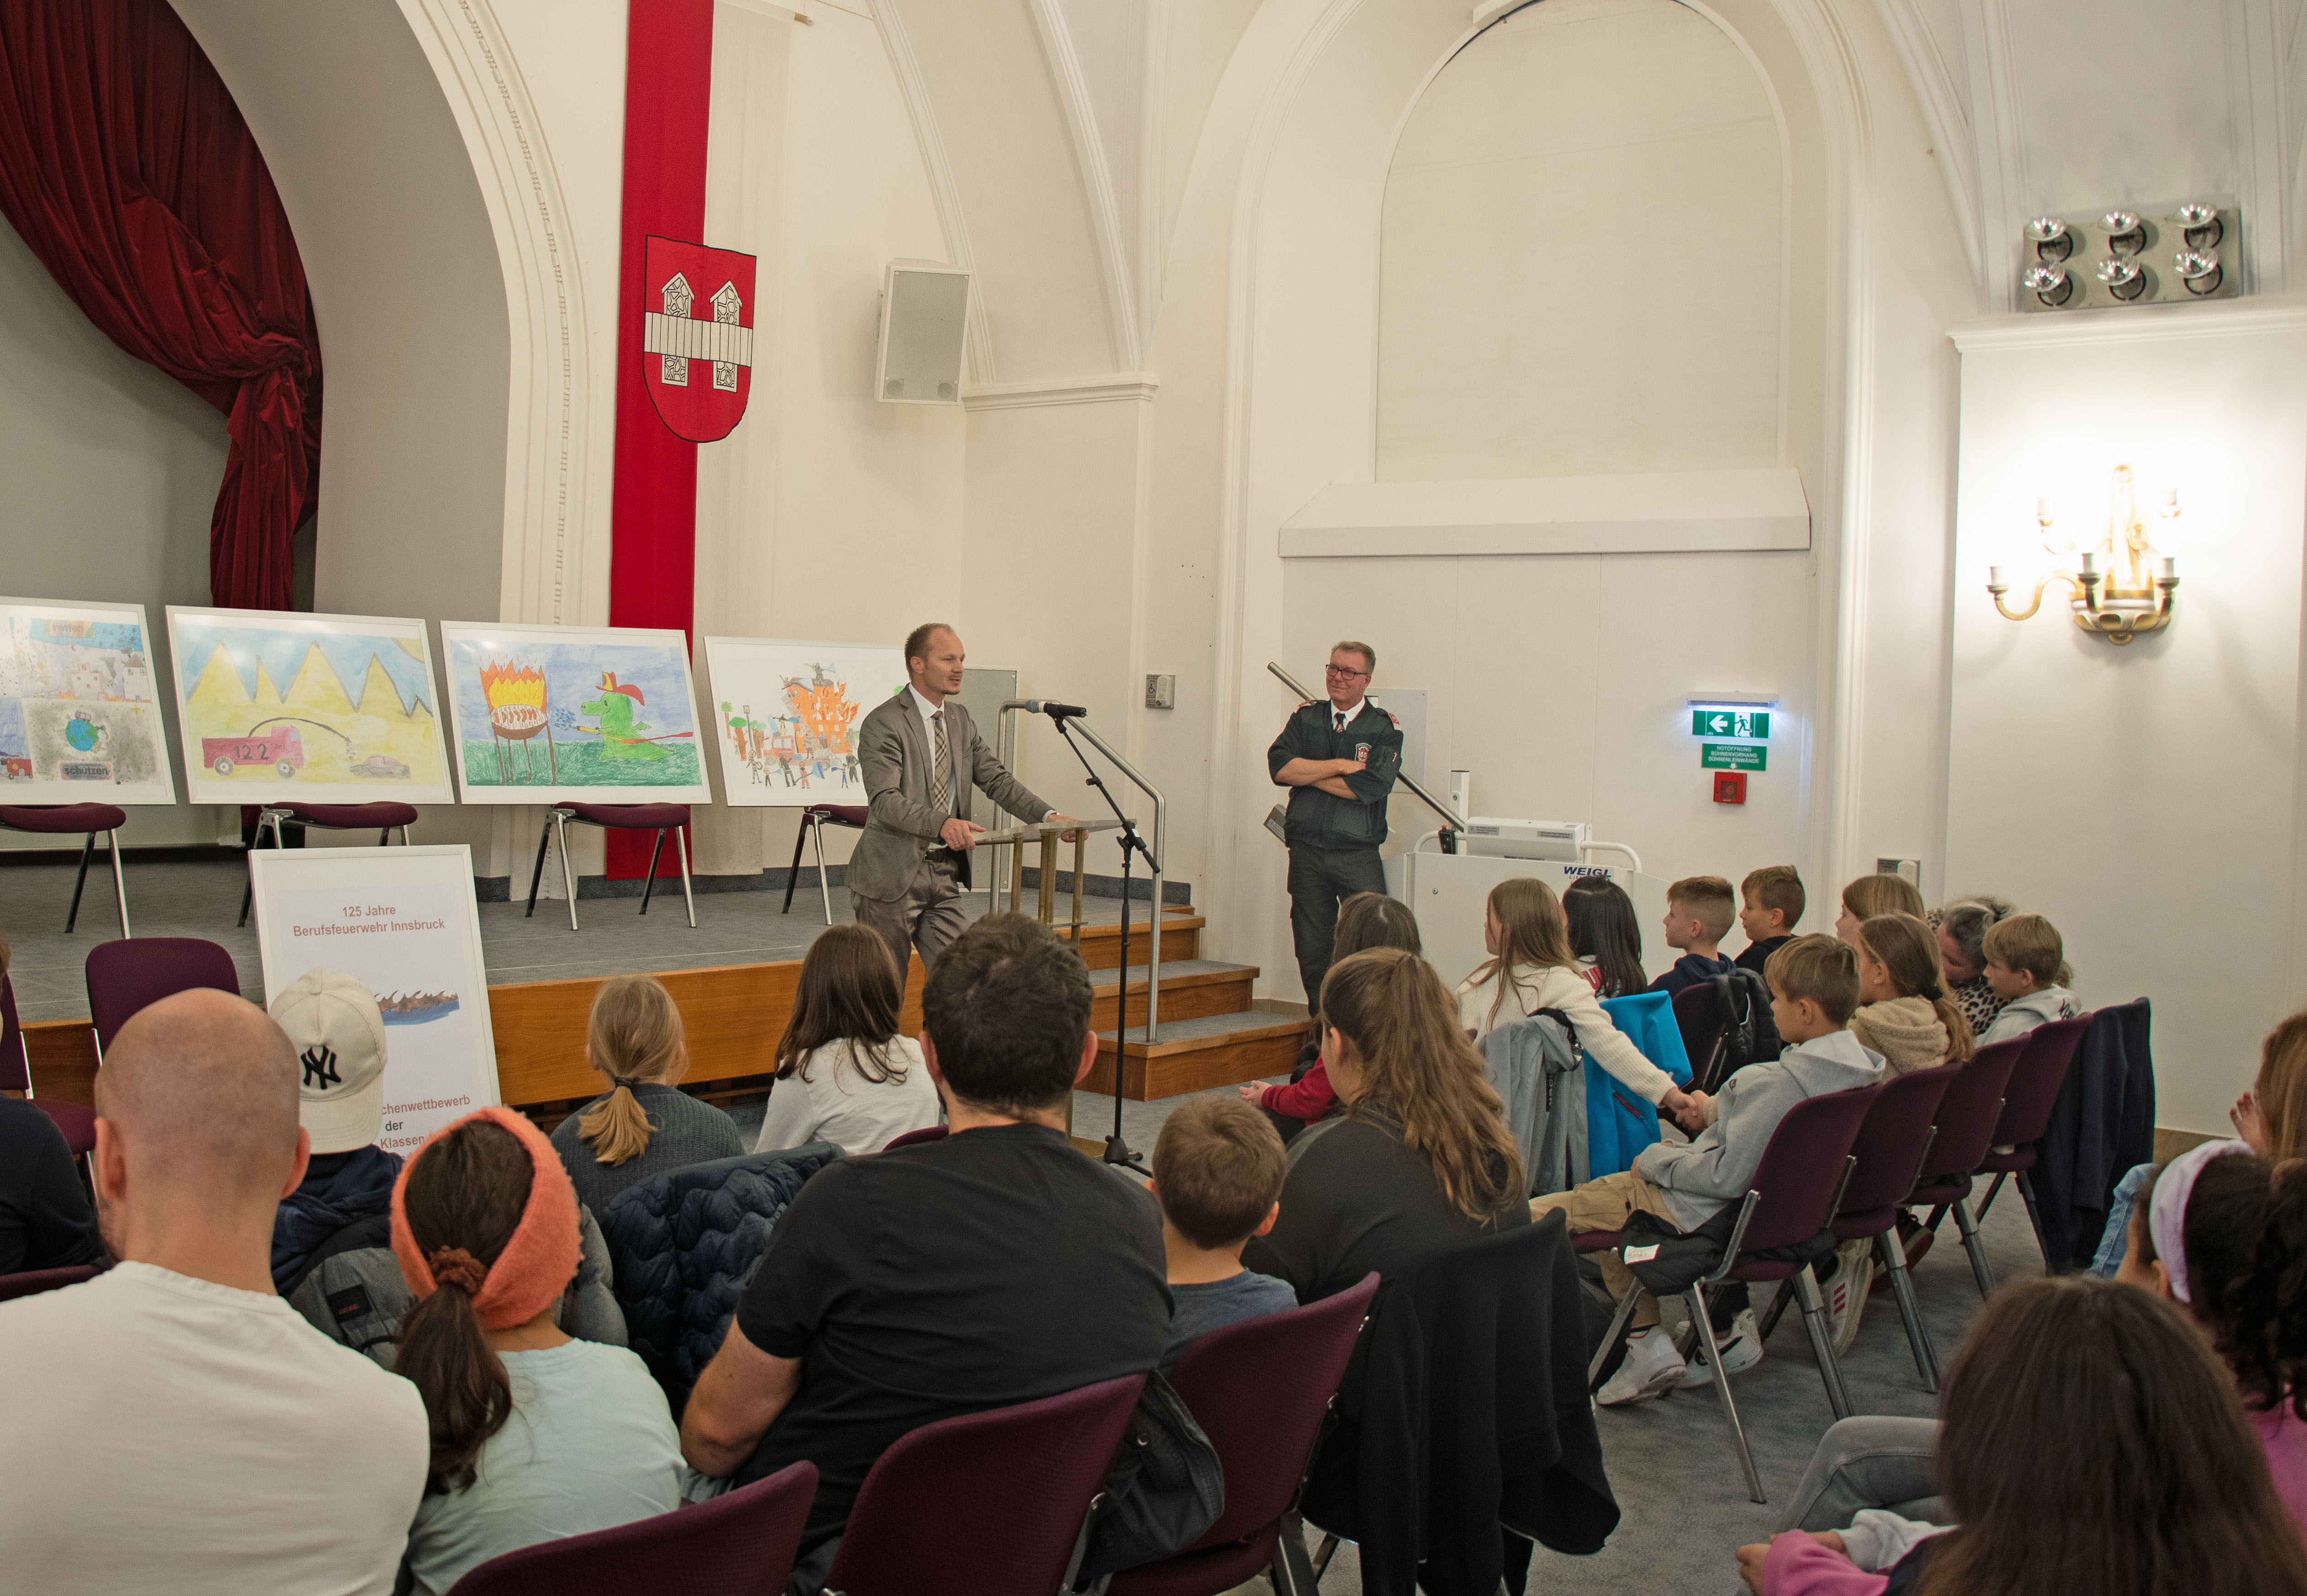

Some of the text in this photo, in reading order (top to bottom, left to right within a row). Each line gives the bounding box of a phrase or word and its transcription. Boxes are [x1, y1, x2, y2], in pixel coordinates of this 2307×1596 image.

[1564, 866, 1611, 878] WEIGL
[343, 905, 396, 917] 125 Jahre
[293, 918, 445, 937] Berufsfeuerwehr Innsbruck
[300, 1045, 342, 1090] NY
[382, 1094, 470, 1115] chenwettbewerb
[385, 1120, 404, 1132] der
[380, 1135, 425, 1149] Klassen
